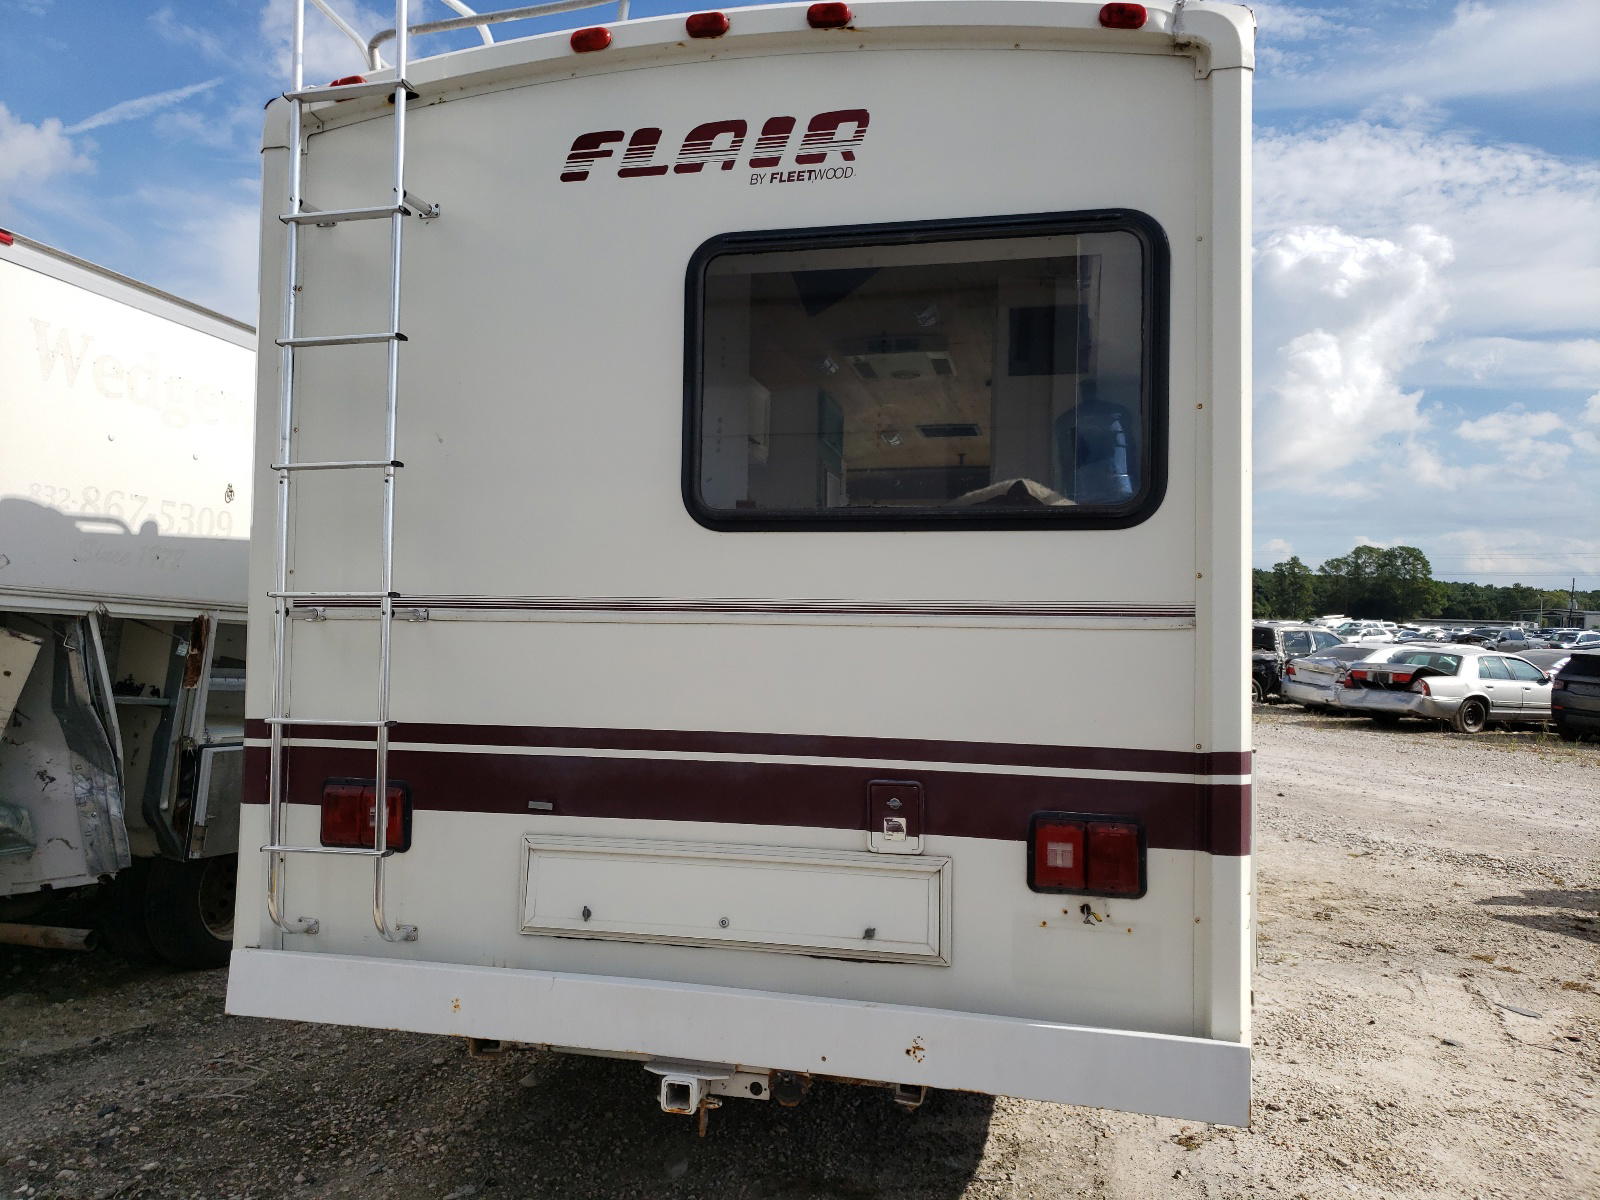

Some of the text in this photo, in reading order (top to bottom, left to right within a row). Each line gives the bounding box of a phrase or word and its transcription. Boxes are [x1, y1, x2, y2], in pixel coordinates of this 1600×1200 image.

[560, 108, 870, 183] FLAIR
[749, 166, 854, 186] BY FLEETWOOD
